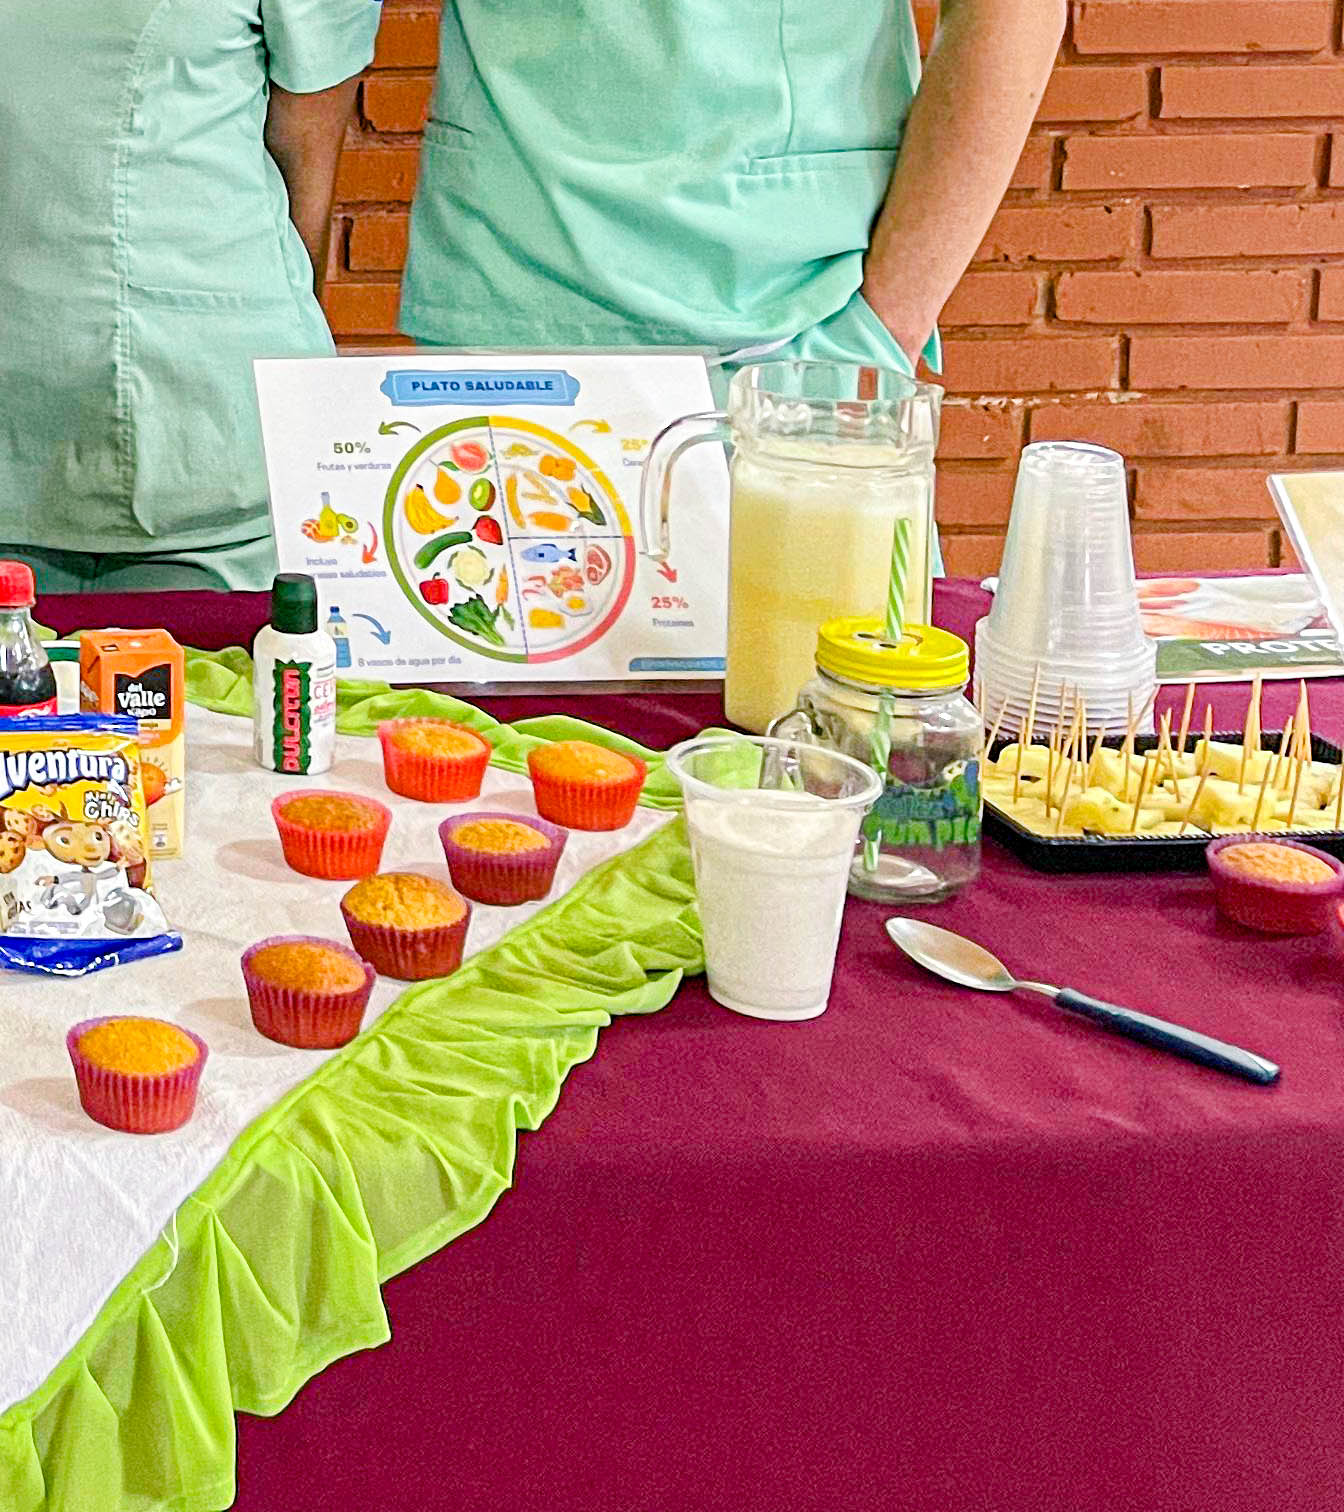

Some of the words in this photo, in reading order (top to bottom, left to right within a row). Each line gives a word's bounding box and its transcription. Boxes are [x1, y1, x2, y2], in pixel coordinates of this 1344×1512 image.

[412, 380, 460, 392] PLATO
[464, 380, 554, 392] SALUDABLE
[333, 441, 372, 455] 50%
[651, 596, 689, 609] 25%
[1200, 639, 1339, 656] PROTE
